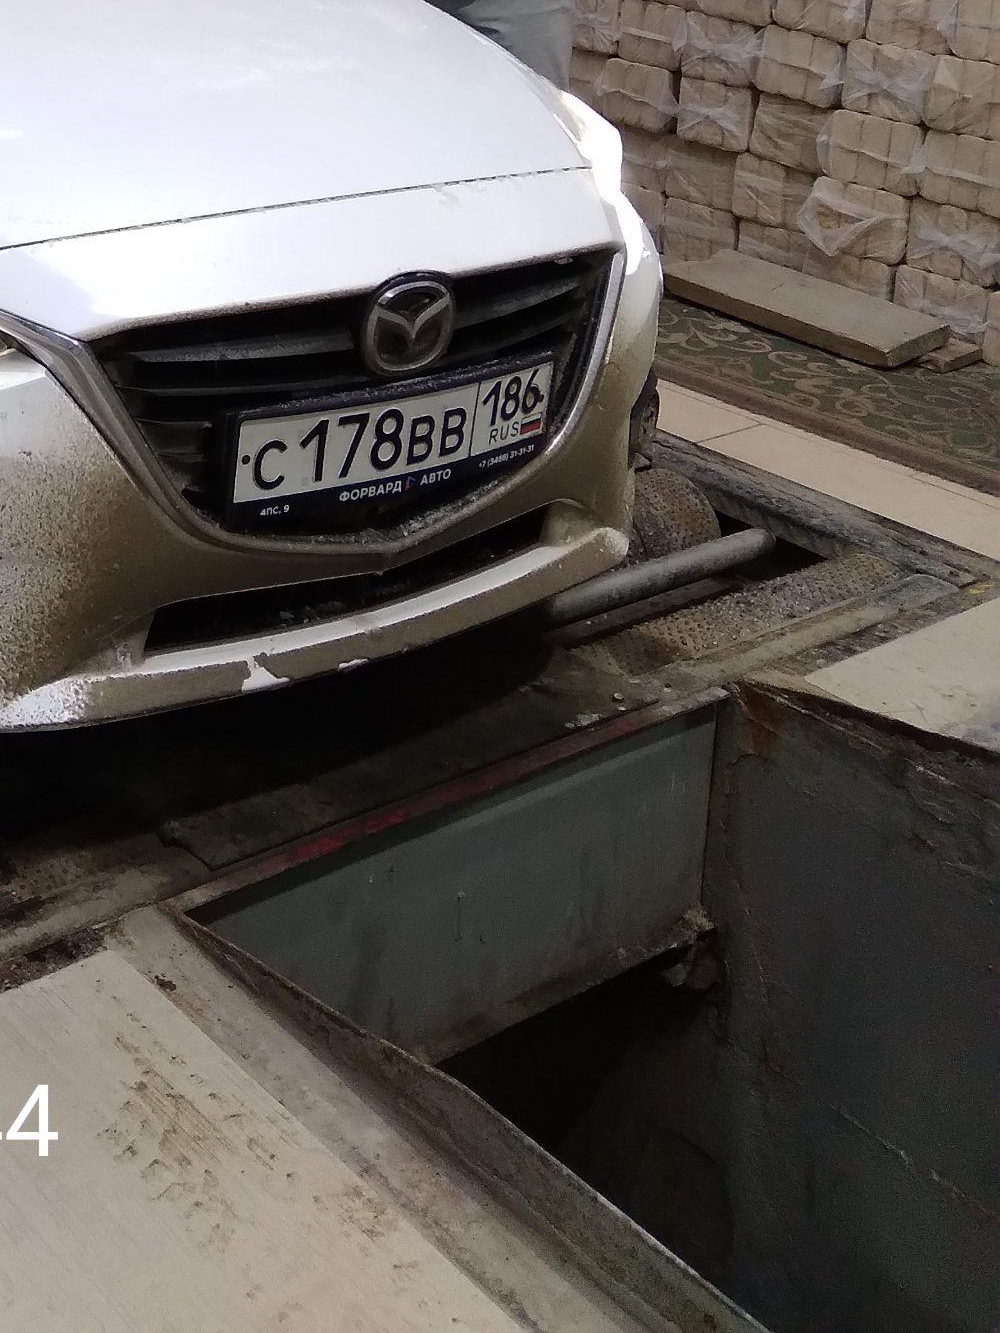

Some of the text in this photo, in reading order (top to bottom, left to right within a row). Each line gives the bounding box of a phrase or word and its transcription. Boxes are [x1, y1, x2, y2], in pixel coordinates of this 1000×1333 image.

[253, 369, 540, 490] С178ВВ 186
[488, 421, 520, 446] RUS
[339, 468, 452, 503] ФОРВАРД АВТО
